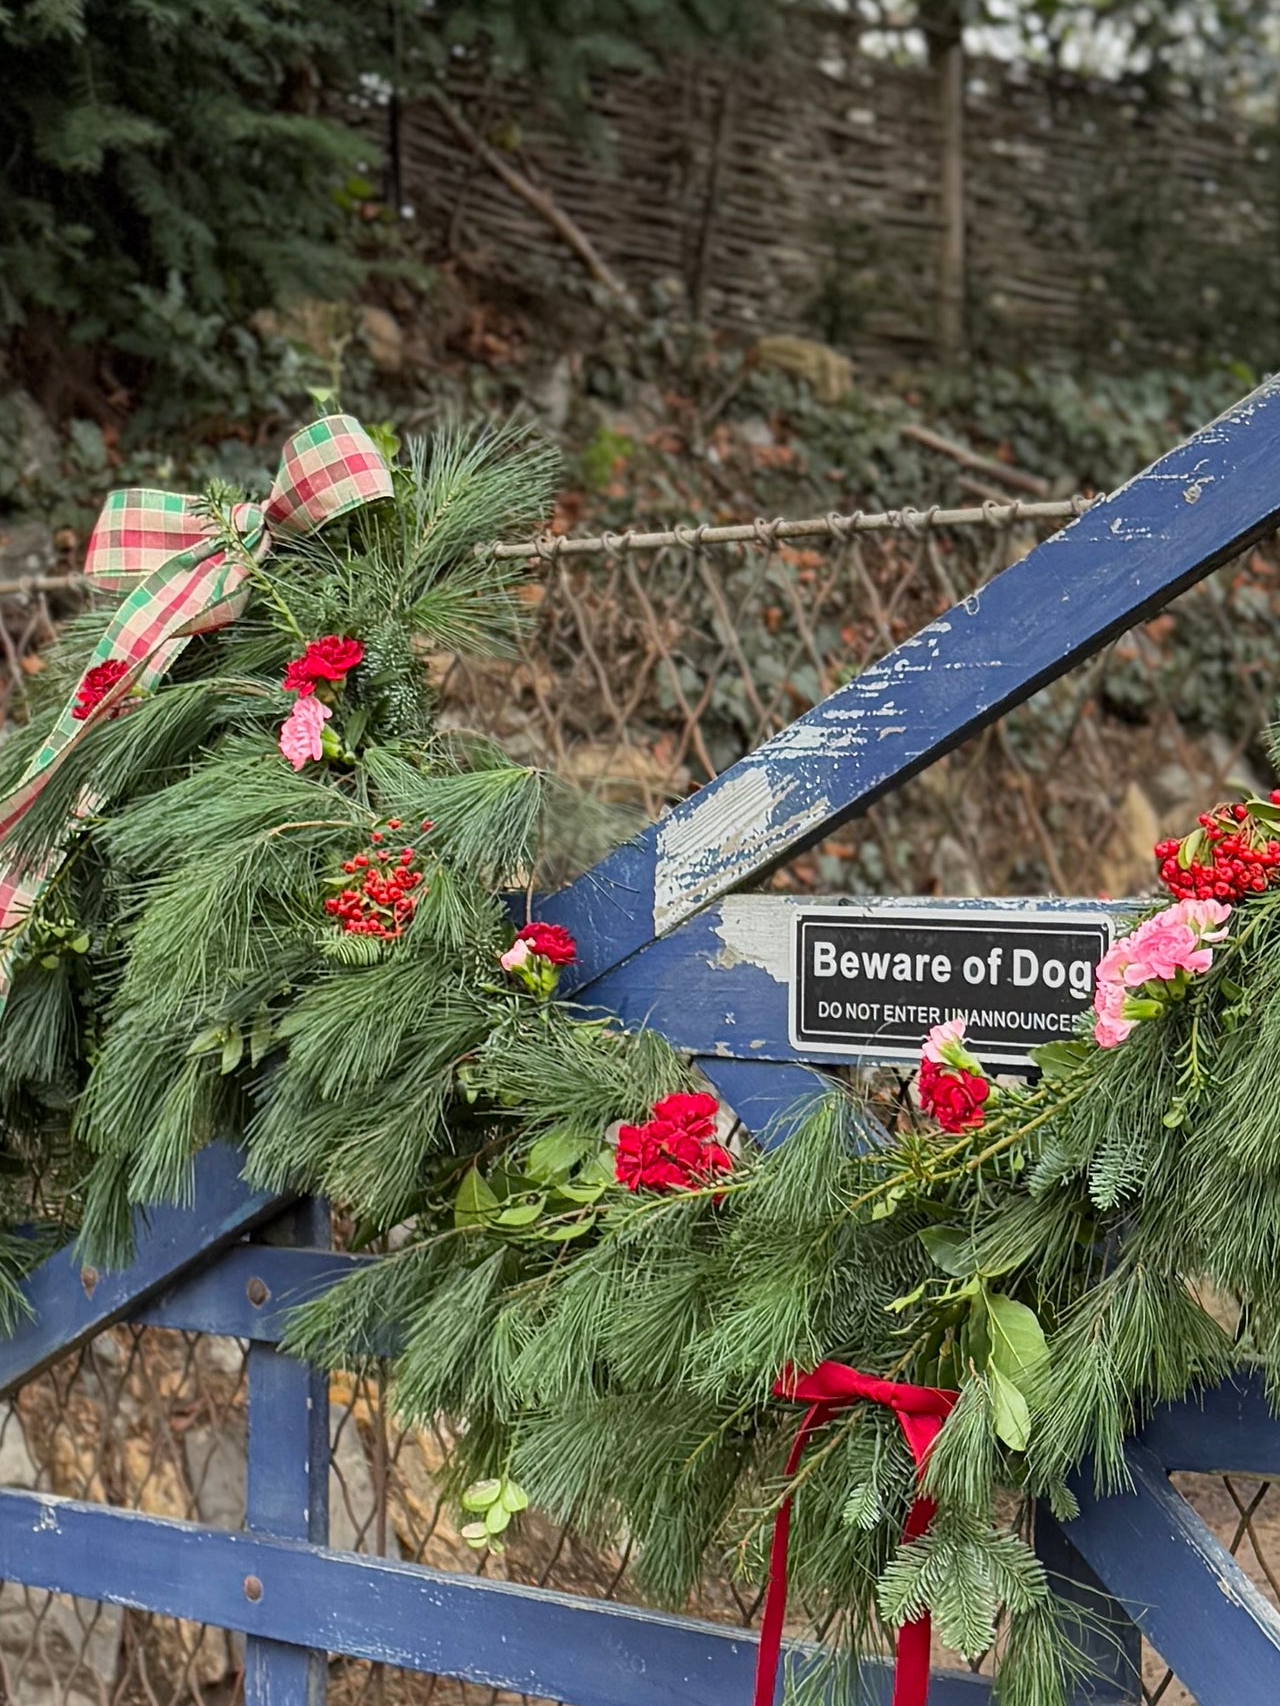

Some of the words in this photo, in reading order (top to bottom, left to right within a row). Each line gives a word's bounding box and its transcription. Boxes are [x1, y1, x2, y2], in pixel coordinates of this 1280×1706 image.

[813, 941, 952, 983] Beware
[963, 947, 1003, 986] of
[1012, 948, 1092, 1000] Dog
[818, 1001, 842, 1019] DO
[845, 1003, 881, 1021] NOT
[883, 1004, 941, 1025] ENTER
